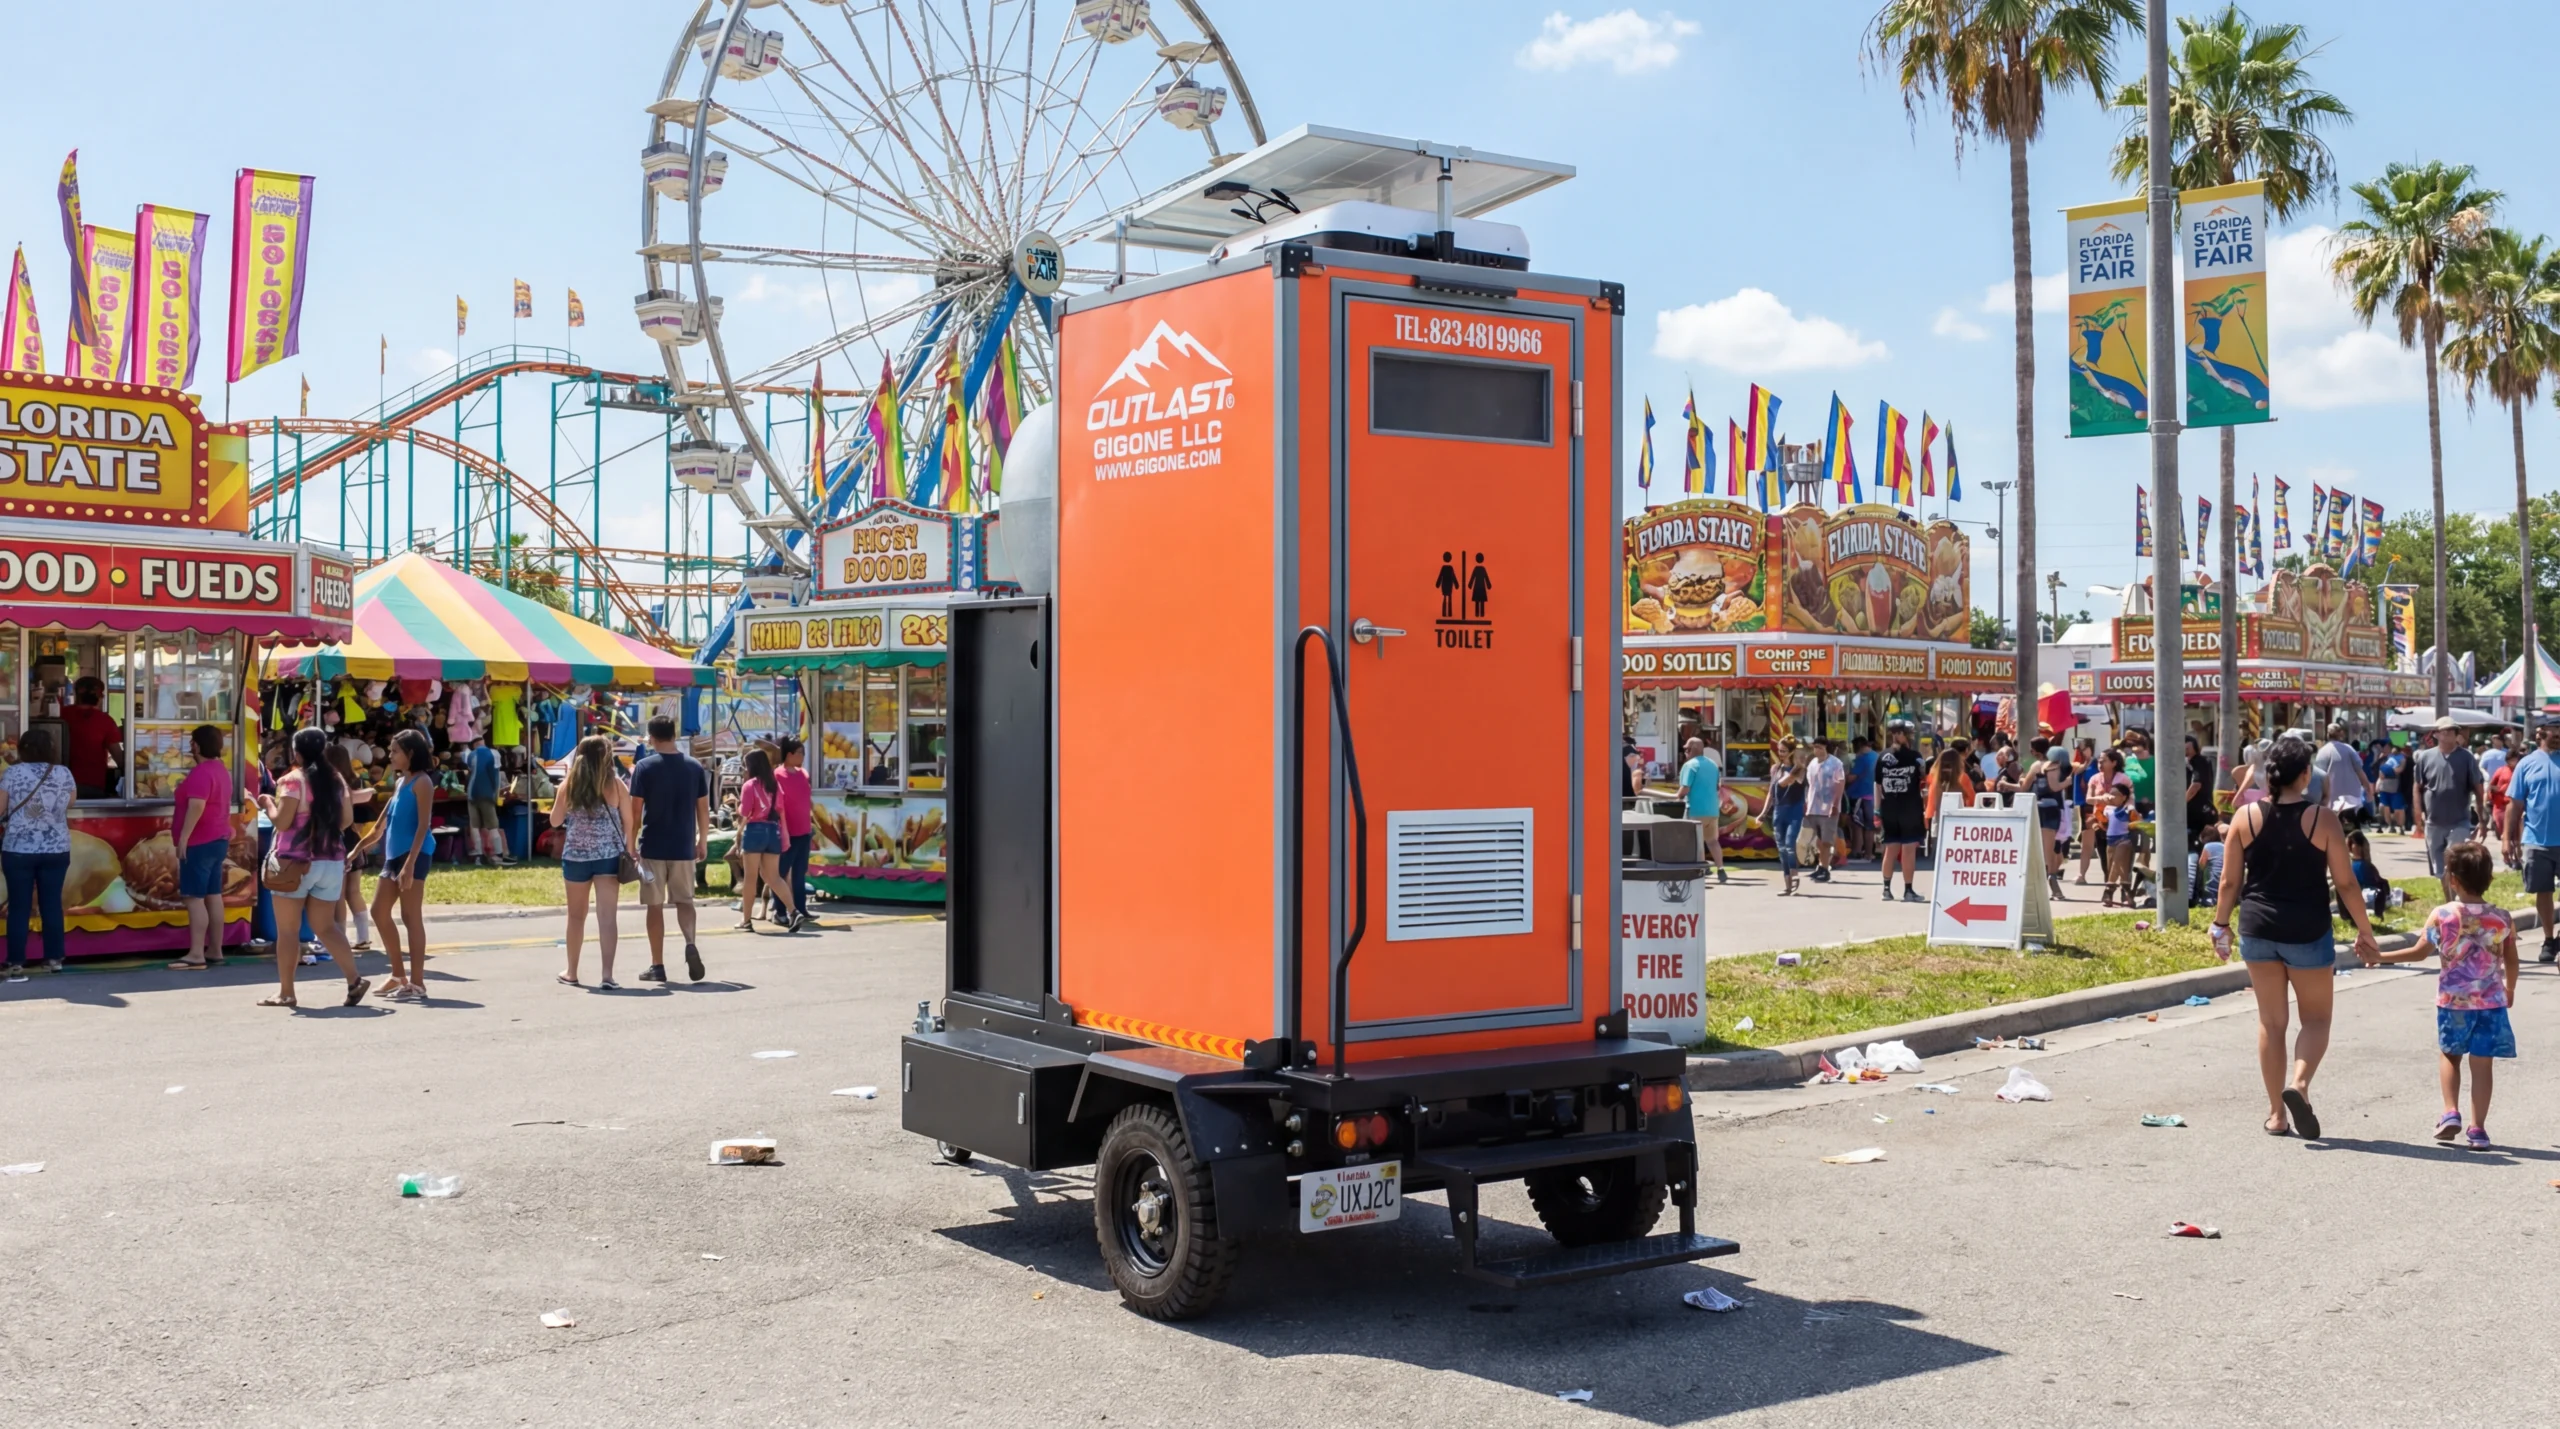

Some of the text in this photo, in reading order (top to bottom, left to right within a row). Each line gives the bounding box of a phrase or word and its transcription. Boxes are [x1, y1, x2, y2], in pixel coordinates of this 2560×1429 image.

[2194, 216, 2252, 232] FLORIDA
[2079, 233, 2134, 249] FLORIDA
[2194, 228, 2252, 247] STATE
[2080, 243, 2134, 263] STATE
[2195, 243, 2253, 268] FAIR
[2080, 260, 2135, 283] FAIR
[1094, 420, 1222, 459] GIGONE LLC
[0, 438, 159, 492] STATE
[1095, 448, 1221, 481] WWW.GIGONE.COM
[140, 557, 280, 602] FUEDS
[1434, 628, 1494, 649] TOILET
[1953, 826, 2013, 843] FLORIDA
[1945, 848, 2018, 864] PORTABLE
[1952, 870, 2007, 887] TRUEER
[1637, 953, 1683, 979] FIRE
[1623, 992, 1698, 1019] ROOMS
